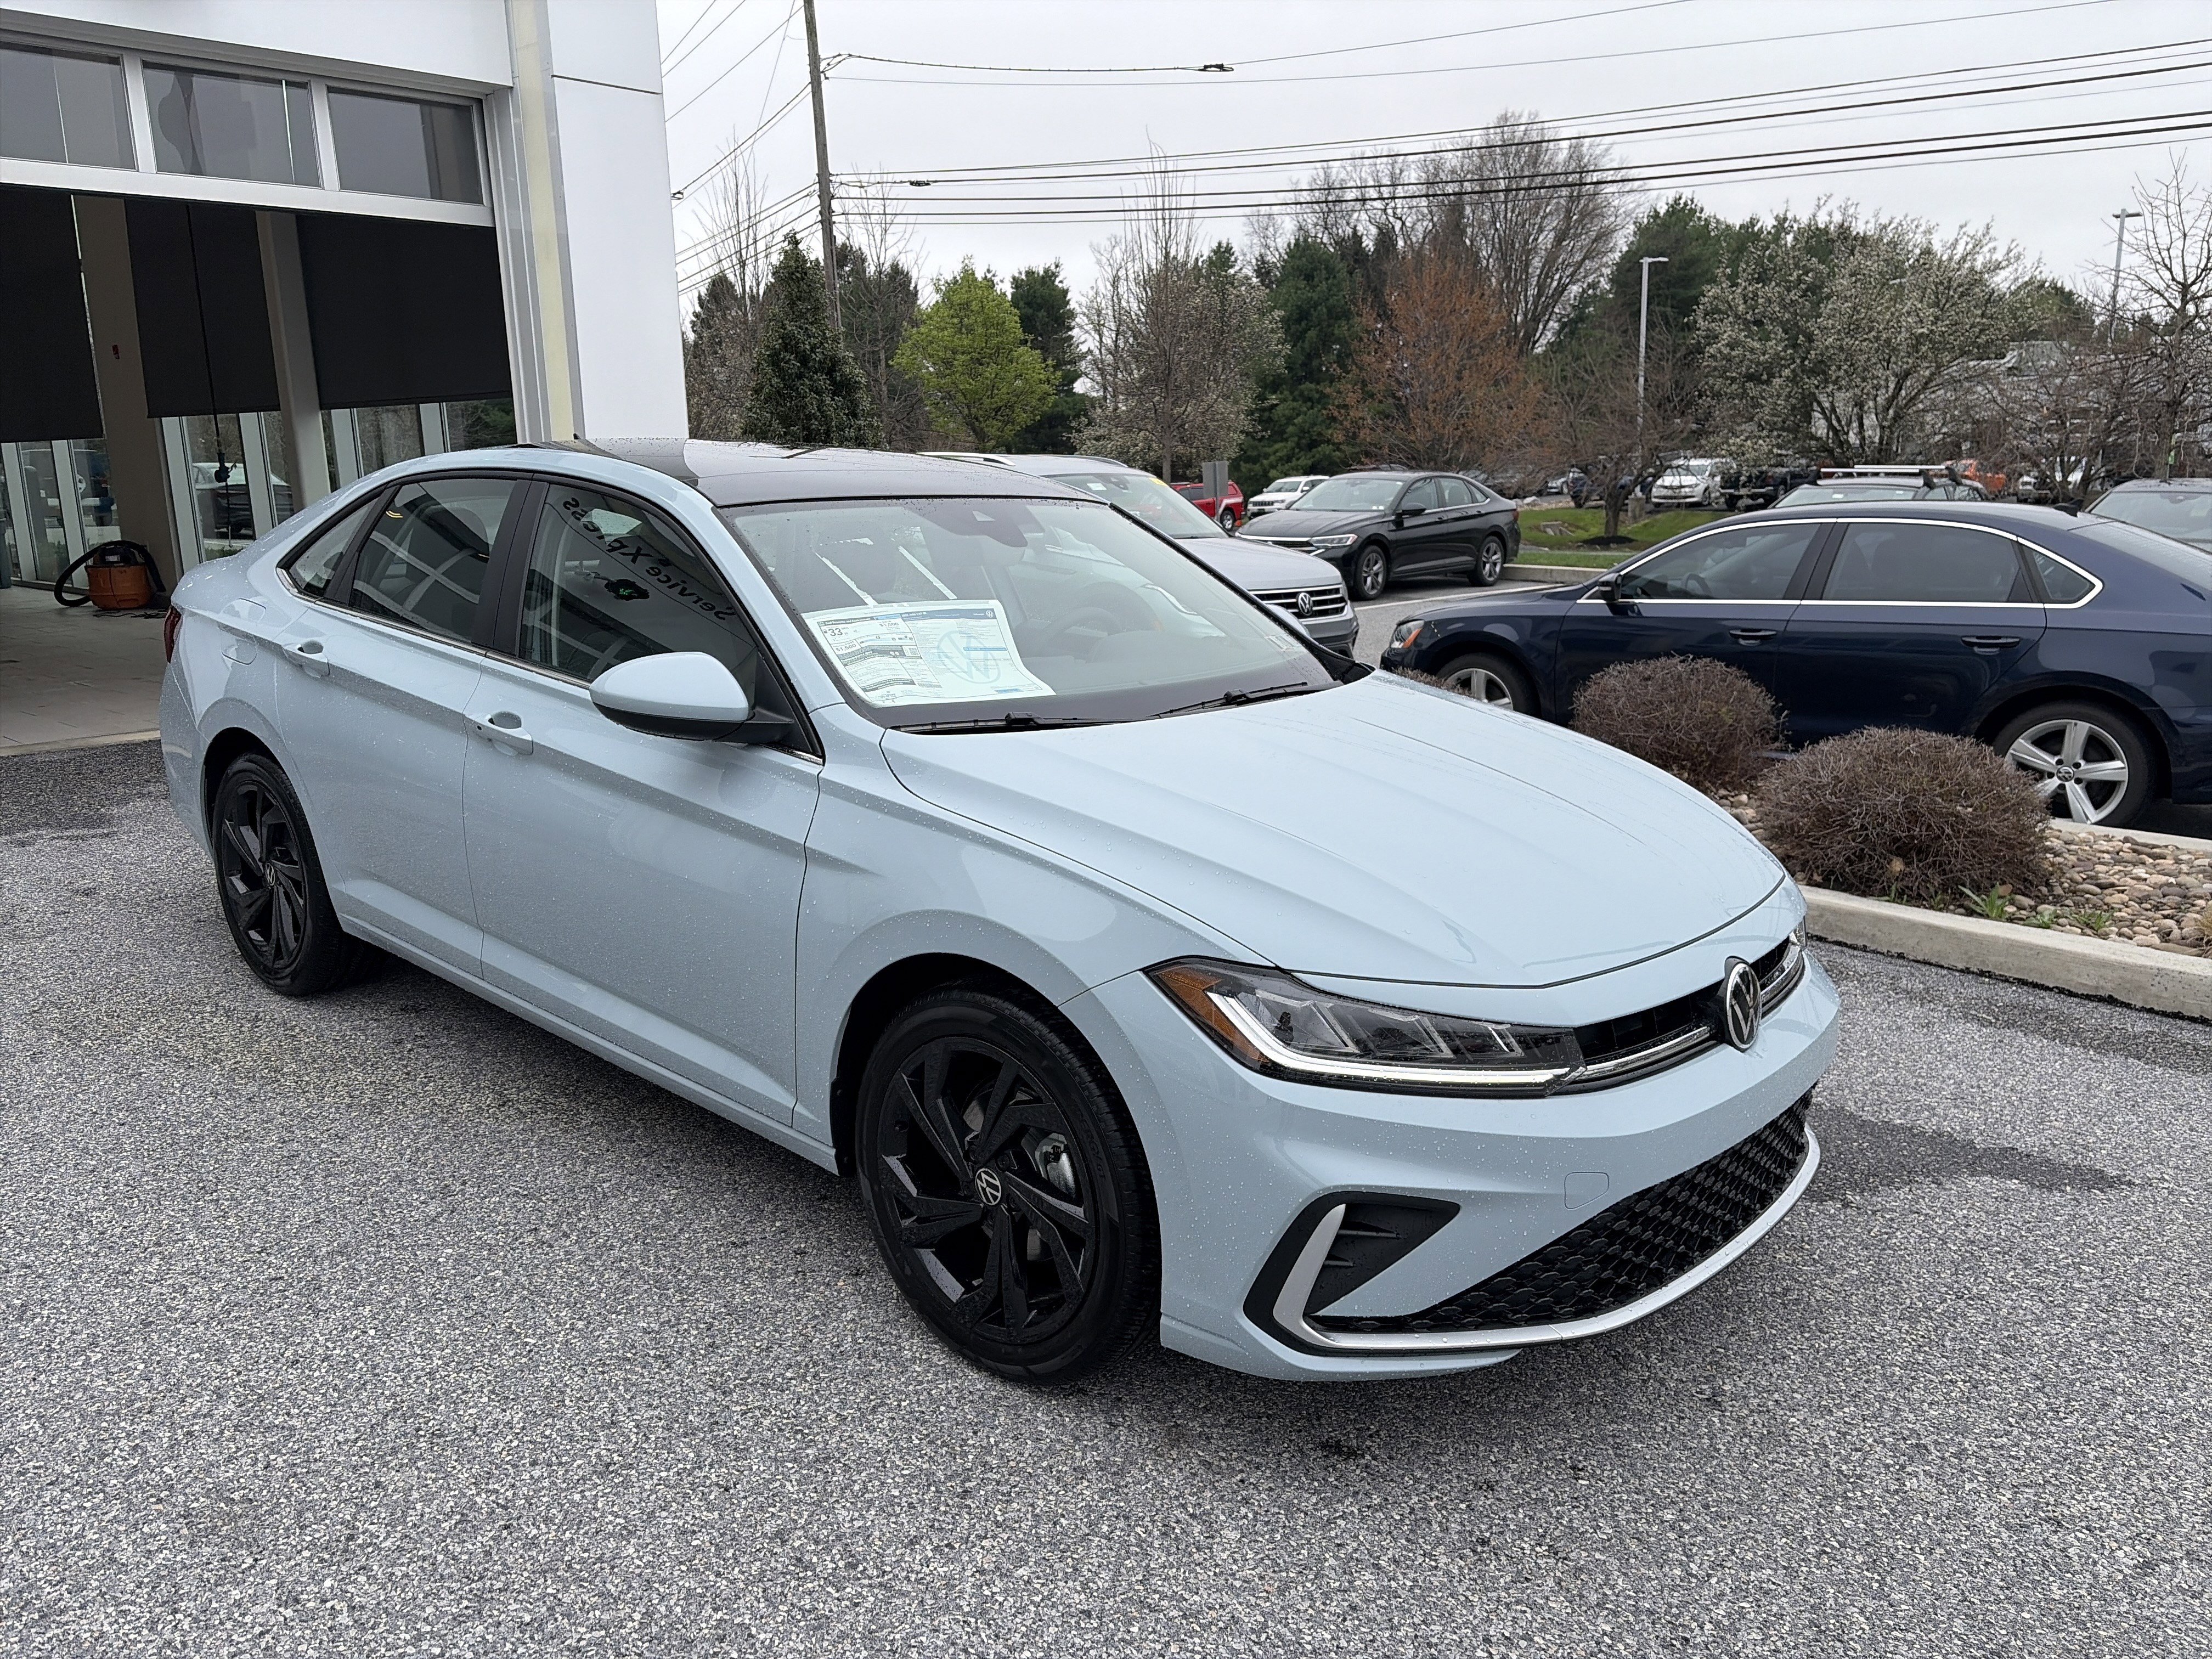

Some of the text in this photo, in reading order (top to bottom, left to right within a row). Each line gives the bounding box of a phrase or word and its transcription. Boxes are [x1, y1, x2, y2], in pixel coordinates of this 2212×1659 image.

[1298, 592, 1312, 616] VW
[828, 628, 843, 636] 33
[836, 644, 856, 652] $1,500
[1726, 963, 1762, 1049] VW
